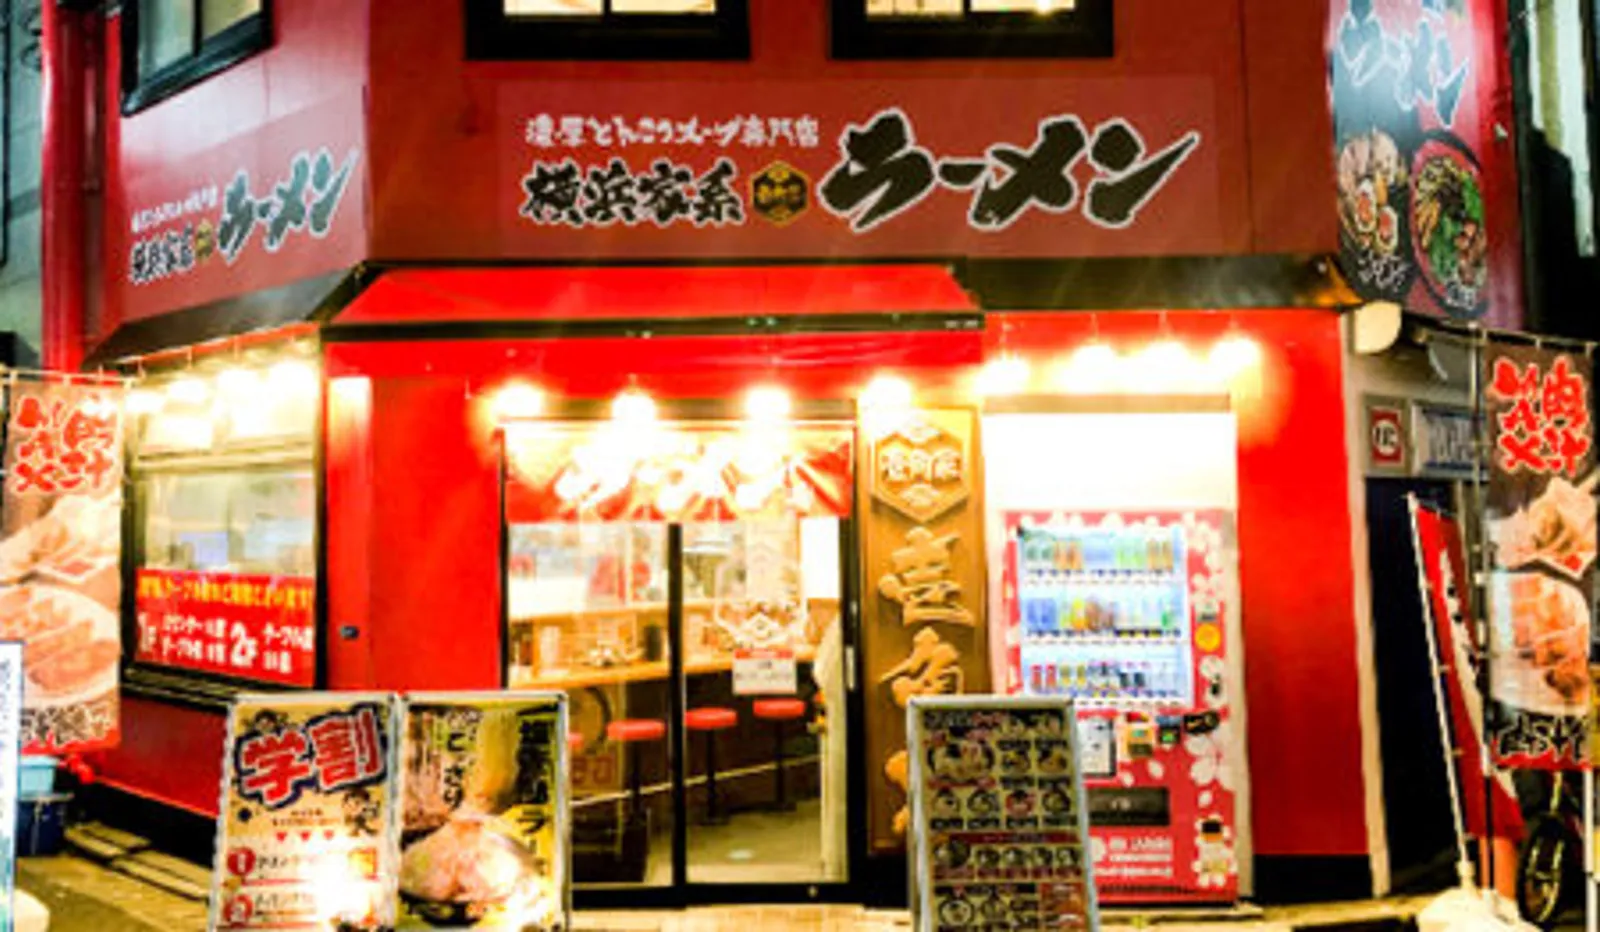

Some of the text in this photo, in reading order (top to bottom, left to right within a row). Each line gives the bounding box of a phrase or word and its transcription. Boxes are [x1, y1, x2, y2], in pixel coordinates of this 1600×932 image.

[216, 147, 361, 266] ラーメン
[519, 156, 744, 228] 横浜家系
[816, 106, 1201, 233] ラーメン
[240, 706, 385, 808] 学割
